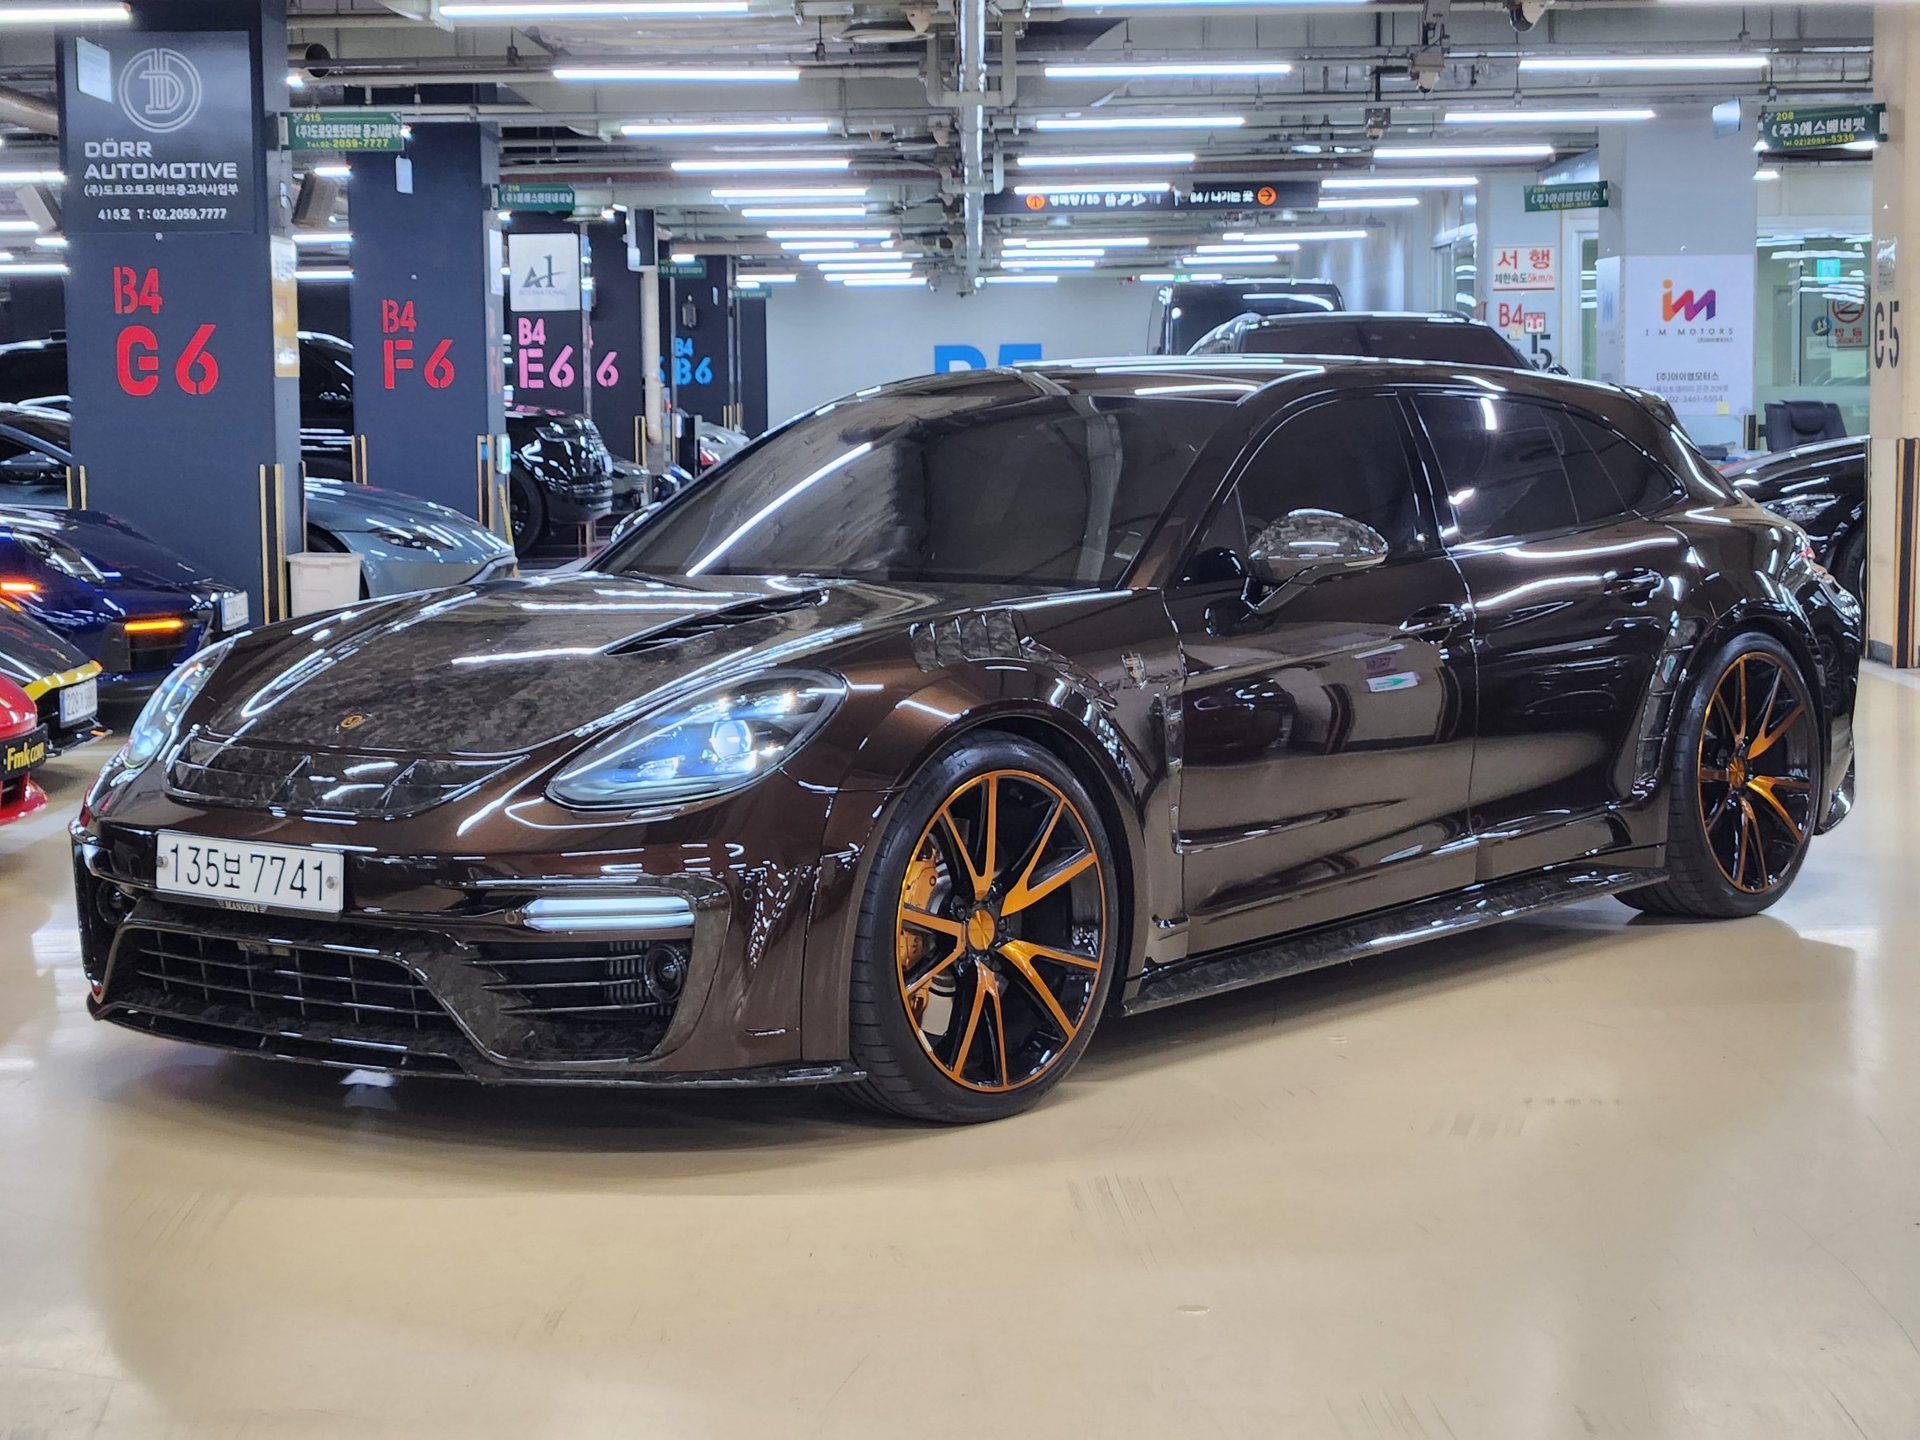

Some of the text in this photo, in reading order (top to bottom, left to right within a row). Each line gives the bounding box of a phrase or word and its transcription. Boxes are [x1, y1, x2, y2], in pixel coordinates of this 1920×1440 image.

[1776, 112, 1794, 121] 208
[84, 137, 152, 158] DÖRR
[84, 162, 238, 180] AUTOMOTIVE
[114, 266, 163, 314] B4
[382, 299, 417, 333] B4
[1498, 303, 1523, 328] B4
[518, 317, 546, 346] B4
[674, 337, 694, 357] B4
